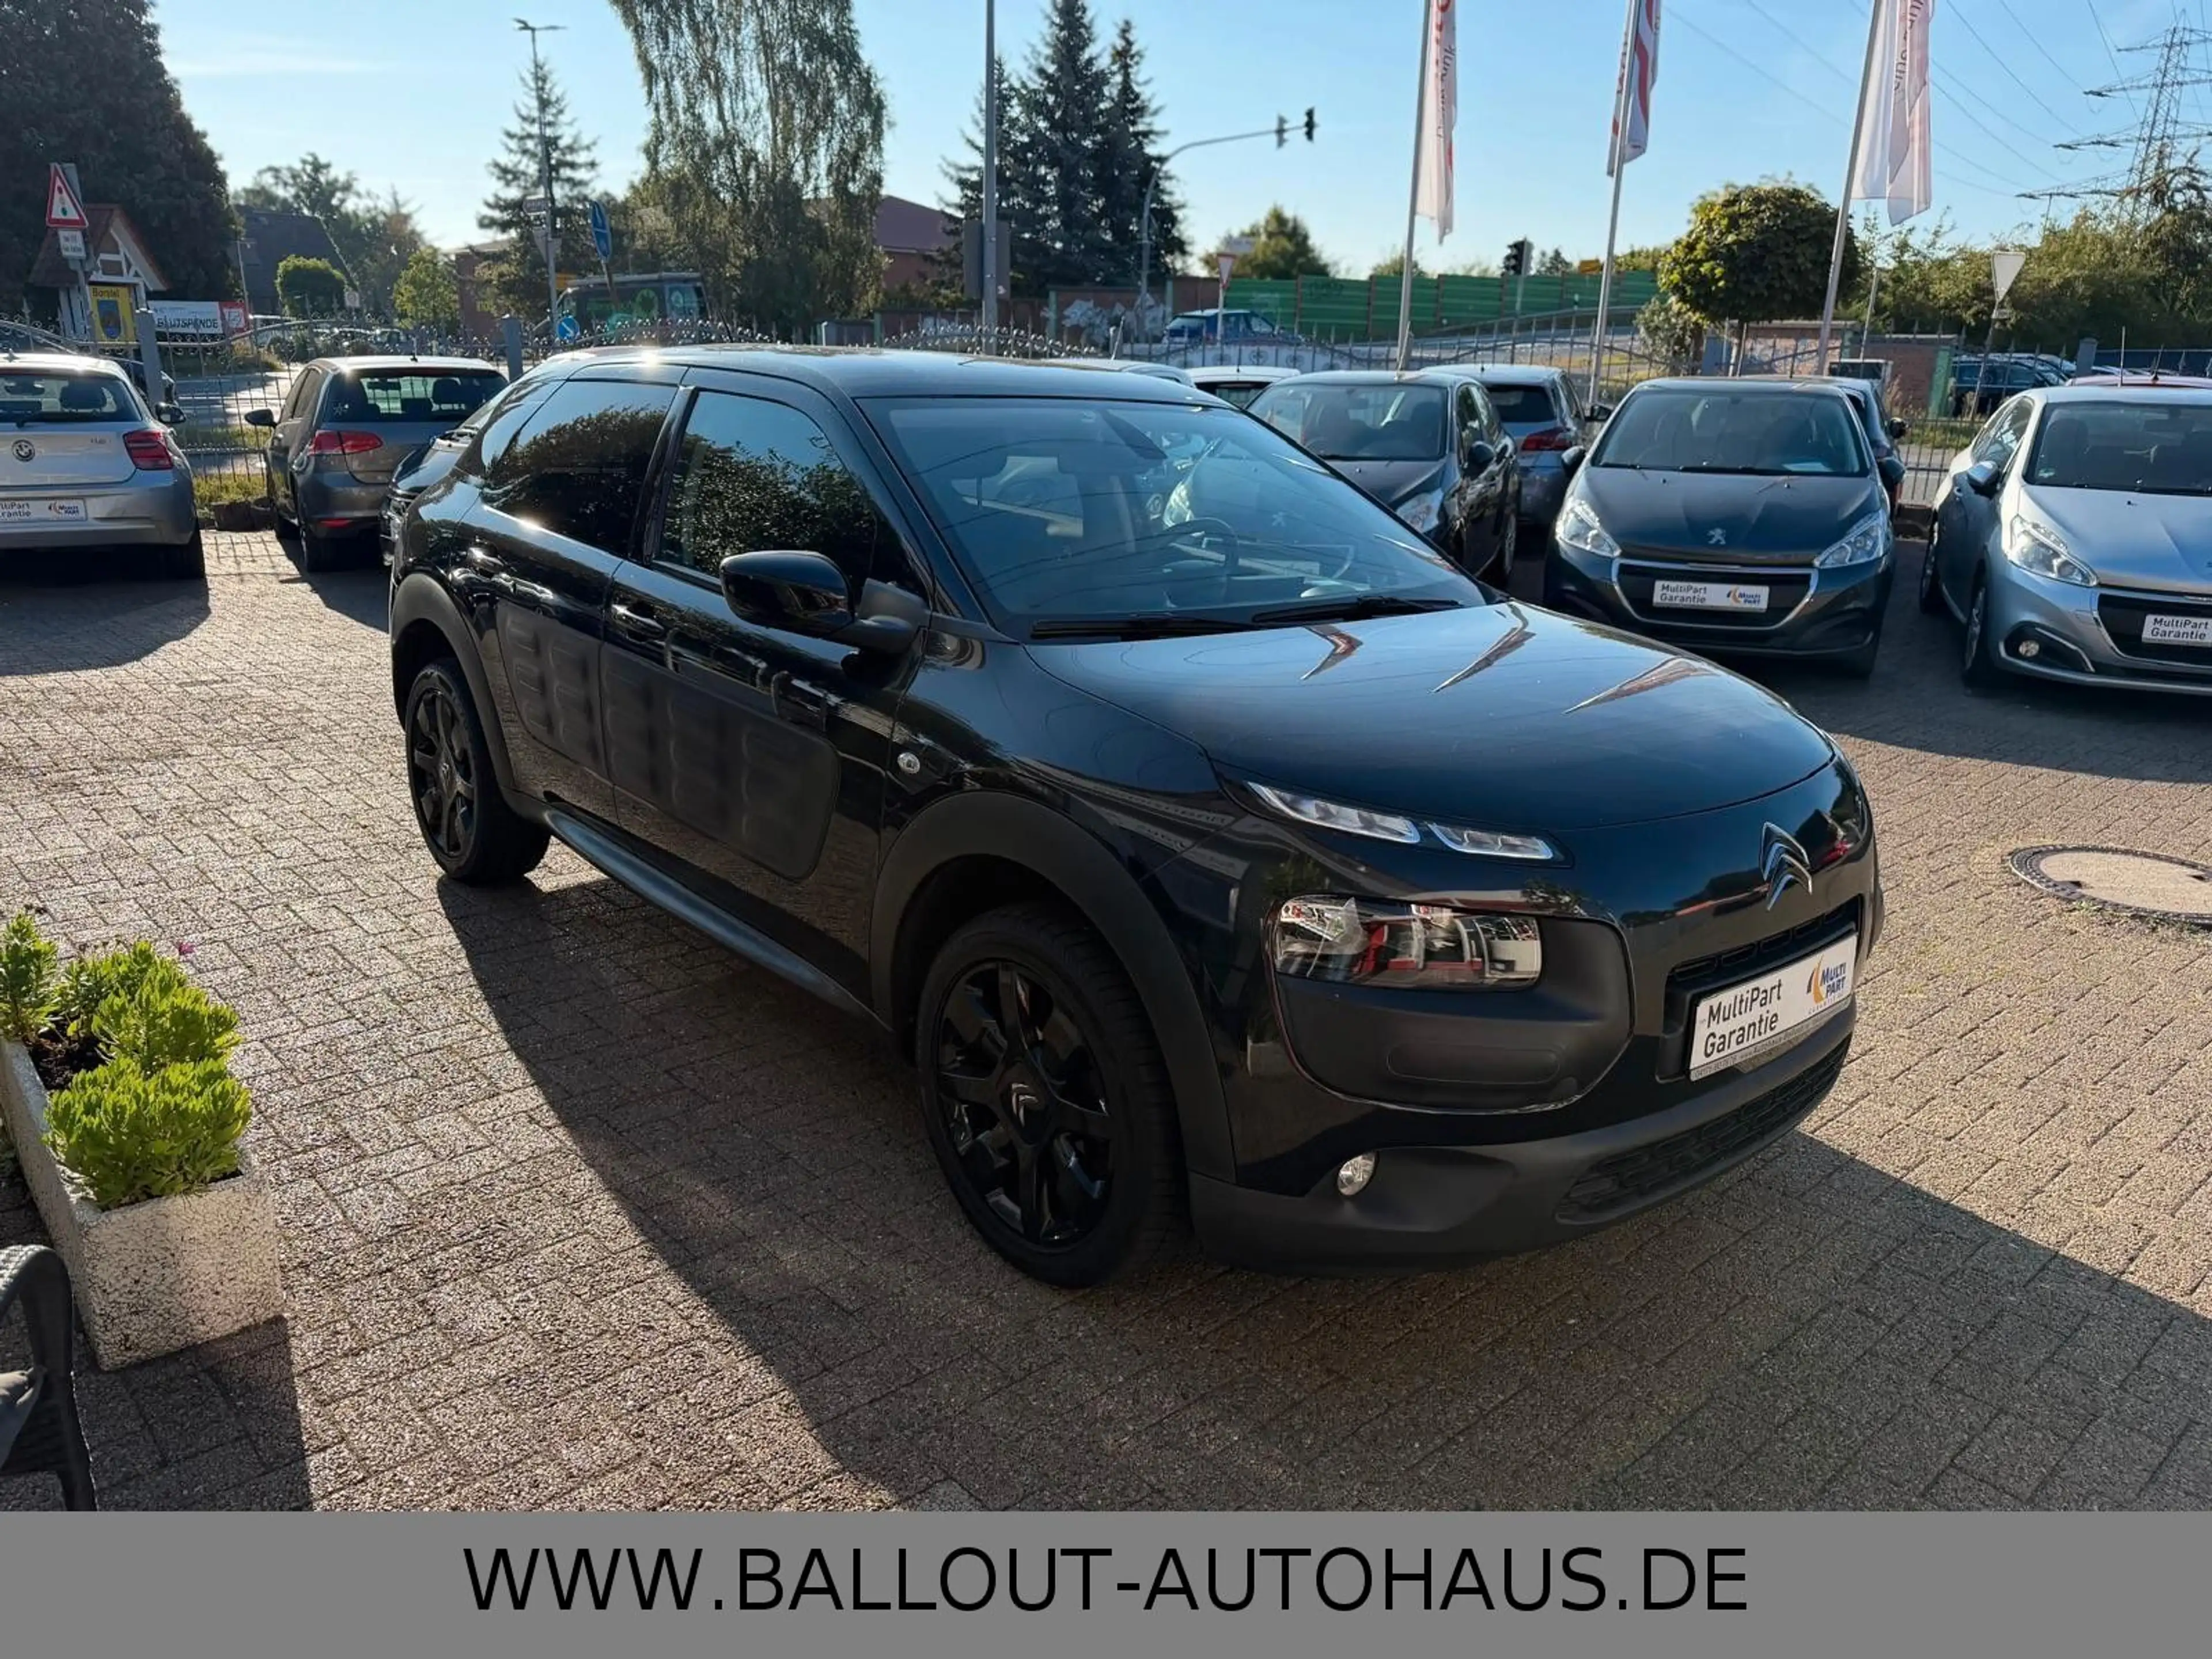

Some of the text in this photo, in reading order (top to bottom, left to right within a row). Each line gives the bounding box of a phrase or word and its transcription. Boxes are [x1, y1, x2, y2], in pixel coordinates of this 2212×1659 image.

[0, 502, 30, 510] ltiPart
[1661, 584, 1707, 594] MultiPart
[1660, 593, 1706, 604] Garantie
[2153, 618, 2209, 629] MultiPart
[2152, 627, 2206, 639] Garantie
[1820, 963, 1846, 986] MULTI
[1826, 976, 1846, 998] PART
[1707, 979, 1782, 1028] MultiPart
[1704, 1009, 1779, 1058] Garantie
